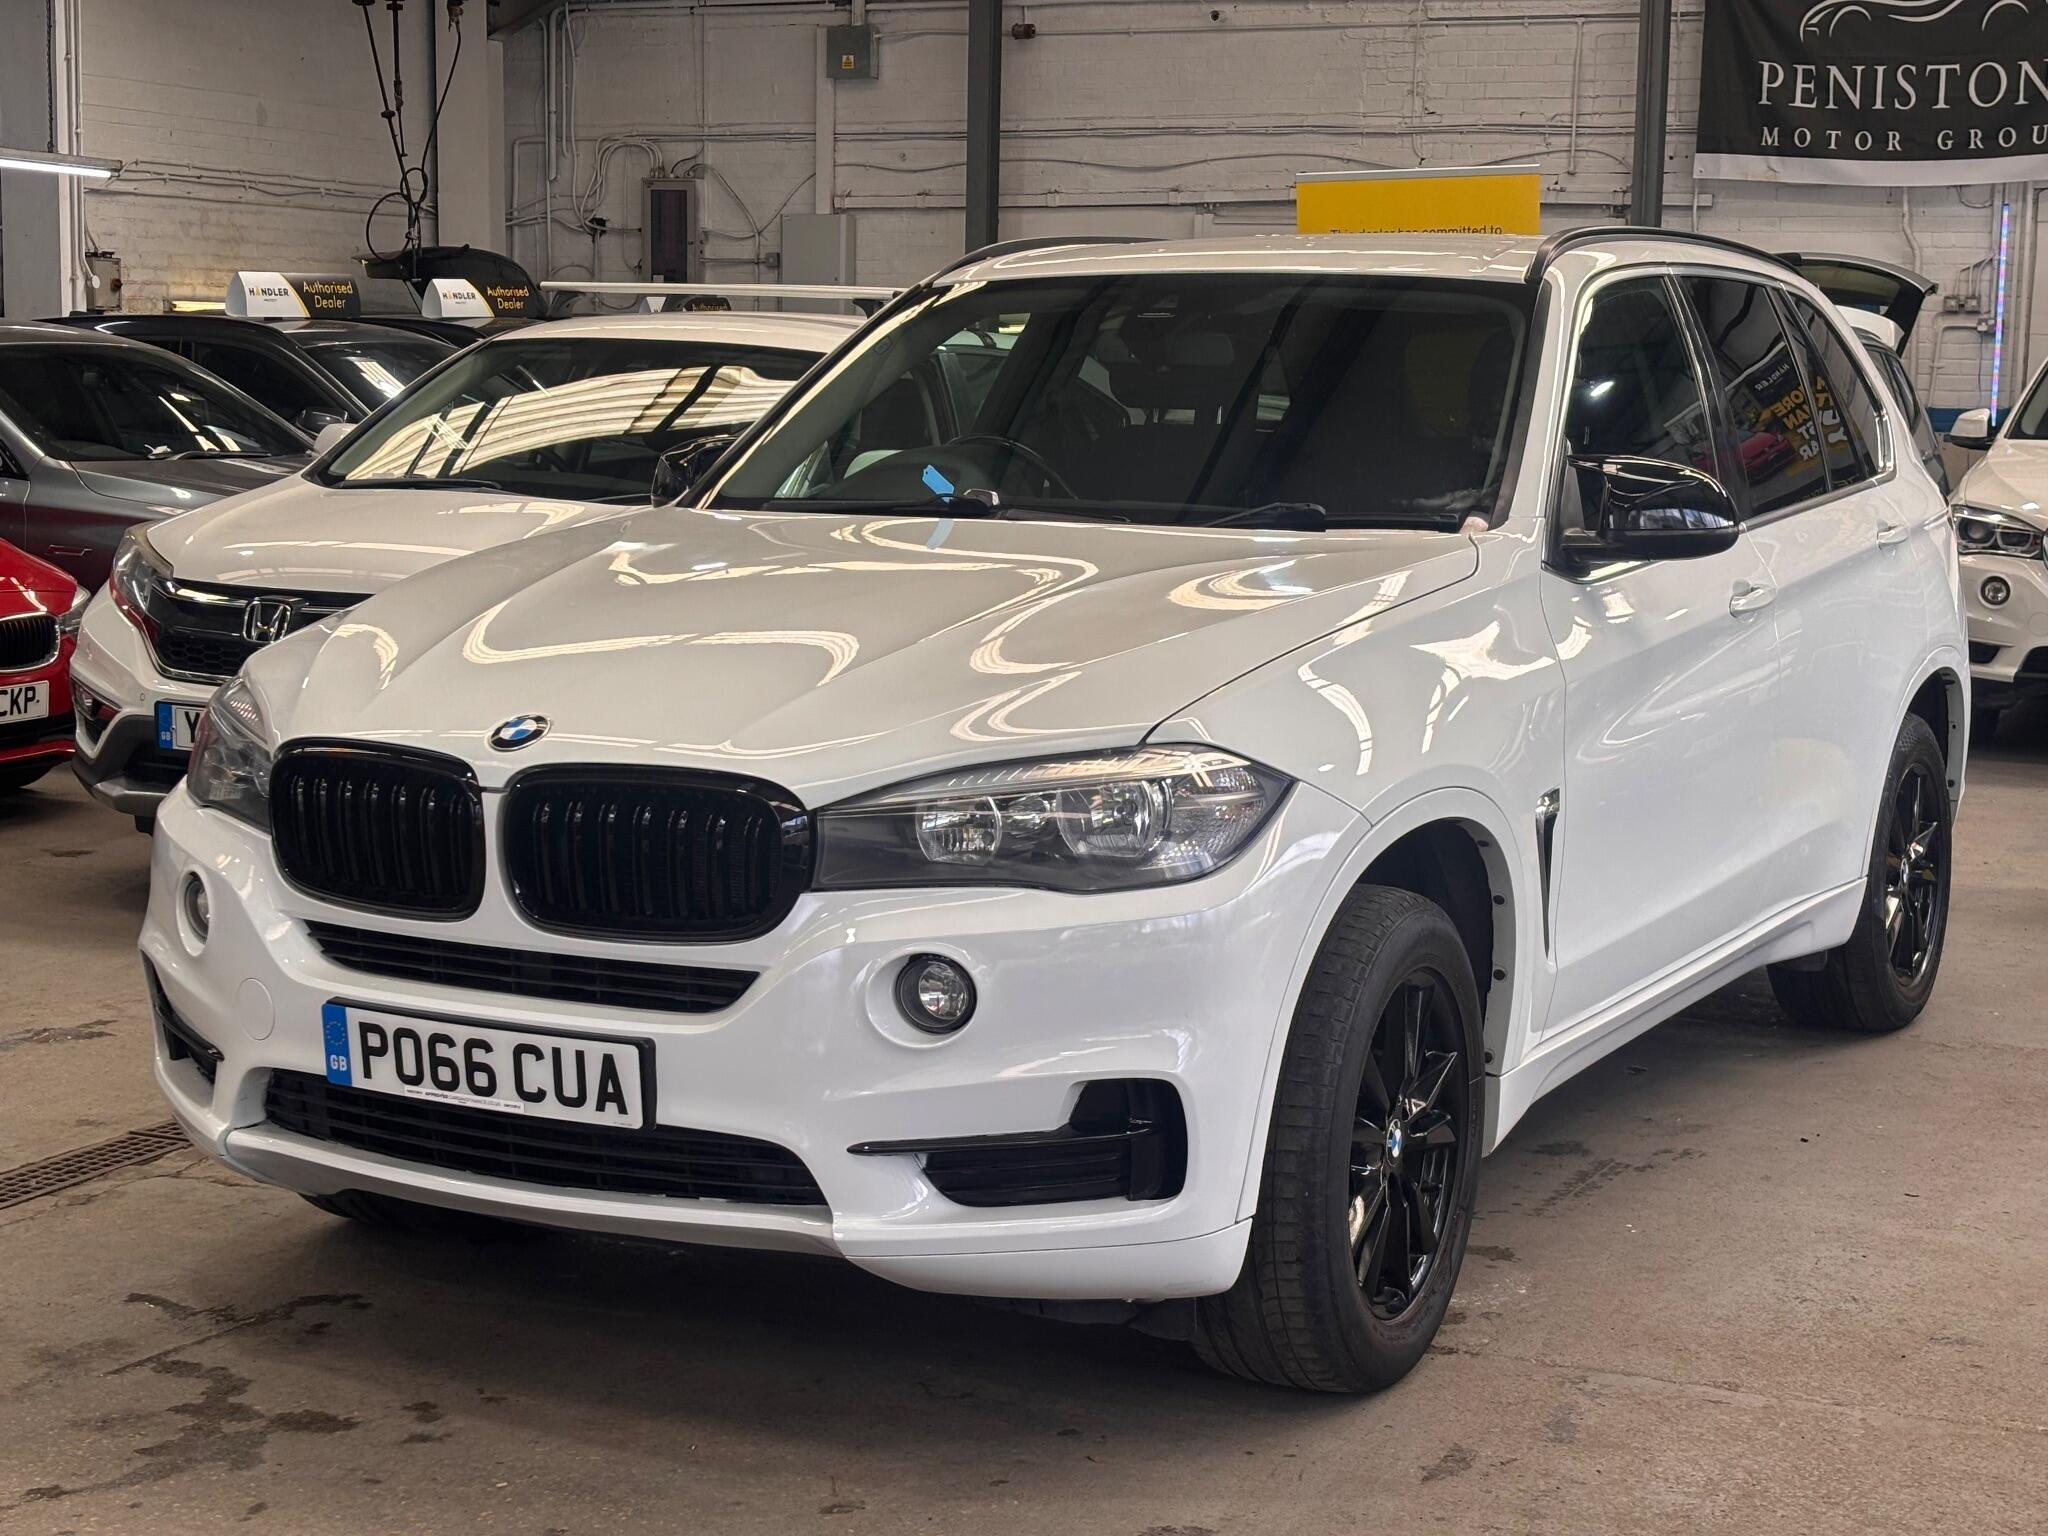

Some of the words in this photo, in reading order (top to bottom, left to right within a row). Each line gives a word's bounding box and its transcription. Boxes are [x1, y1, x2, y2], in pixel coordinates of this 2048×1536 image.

[1761, 126, 1902, 151] MOTOR
[1490, 224, 1502, 235] to
[248, 287, 290, 297] HANDLER
[303, 280, 353, 294] Authorised
[487, 286, 530, 298] Authorised
[314, 295, 346, 309] Dealer
[496, 297, 525, 309] Dealer
[330, 1054, 347, 1071] GB
[358, 1021, 498, 1098] PO66
[512, 1042, 629, 1115] CUA
